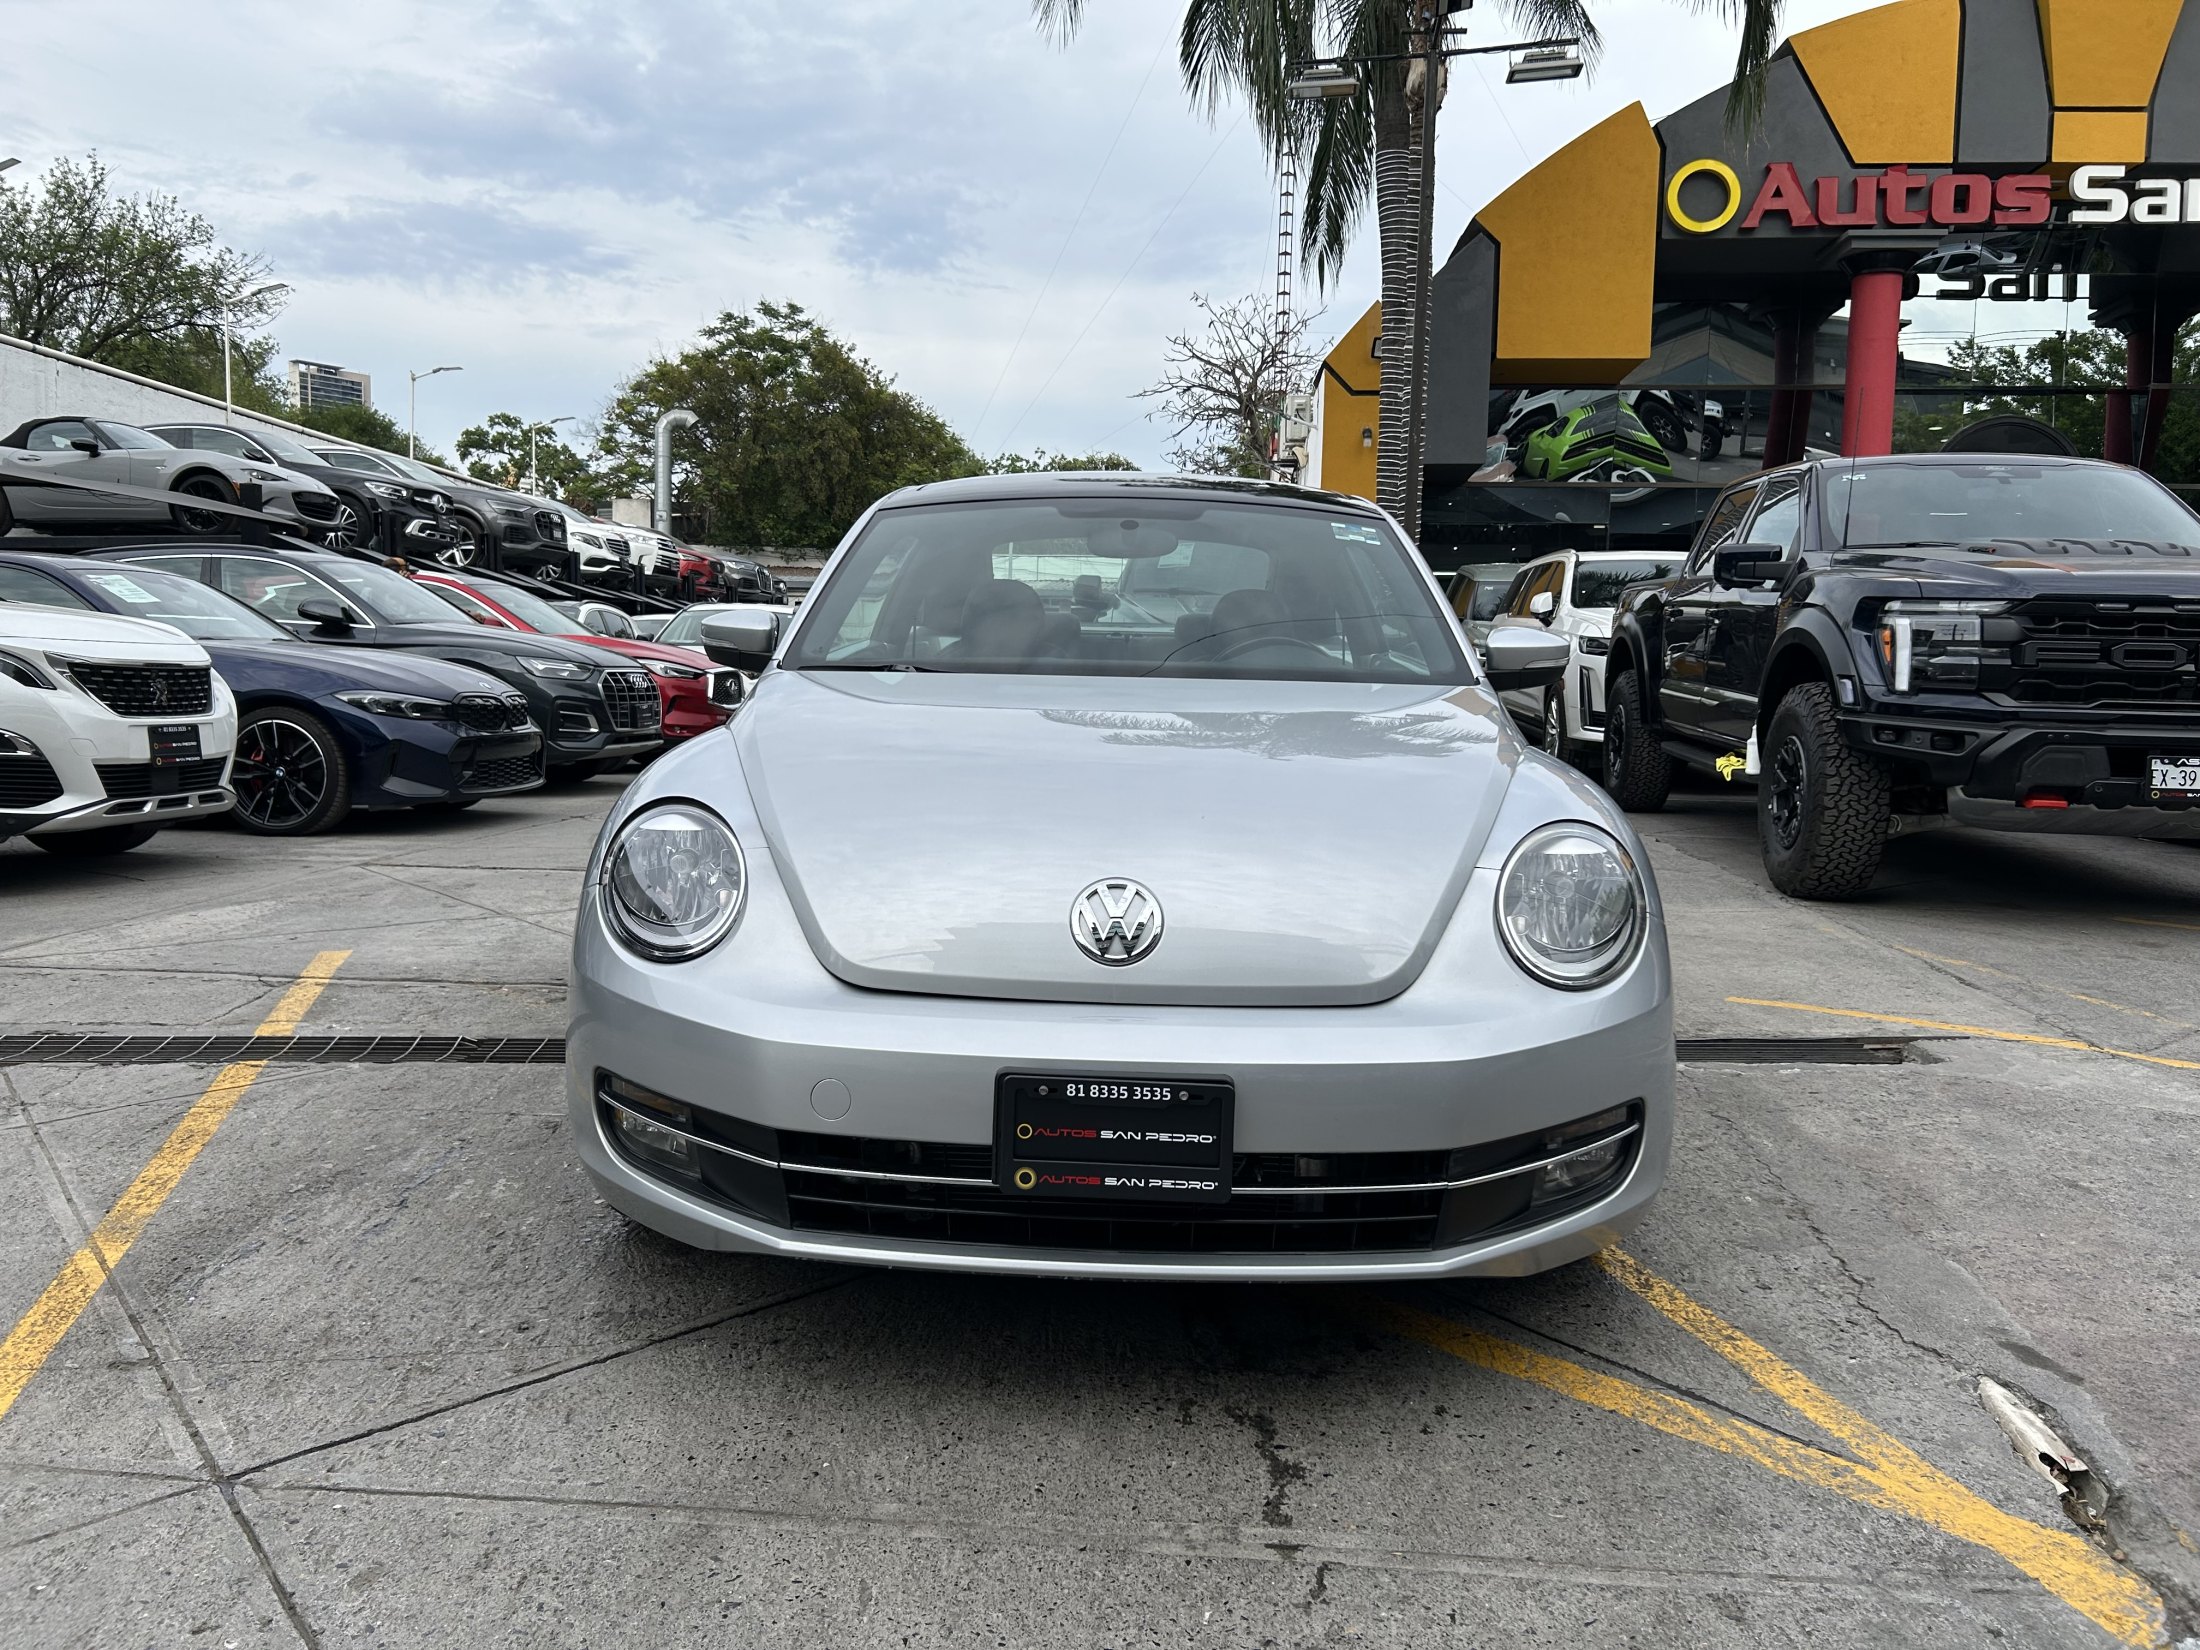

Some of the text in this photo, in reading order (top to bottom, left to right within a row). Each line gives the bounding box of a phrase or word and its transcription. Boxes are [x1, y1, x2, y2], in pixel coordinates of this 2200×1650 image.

[1739, 162, 2051, 229] Autos
[1066, 1083, 1171, 1101] 81 8335 3535
[1034, 1127, 1097, 1138] AUTOS
[1100, 1130, 1142, 1141] SAN
[1039, 1174, 1101, 1185] AUTOS
[1104, 1177, 1145, 1188] SAN
